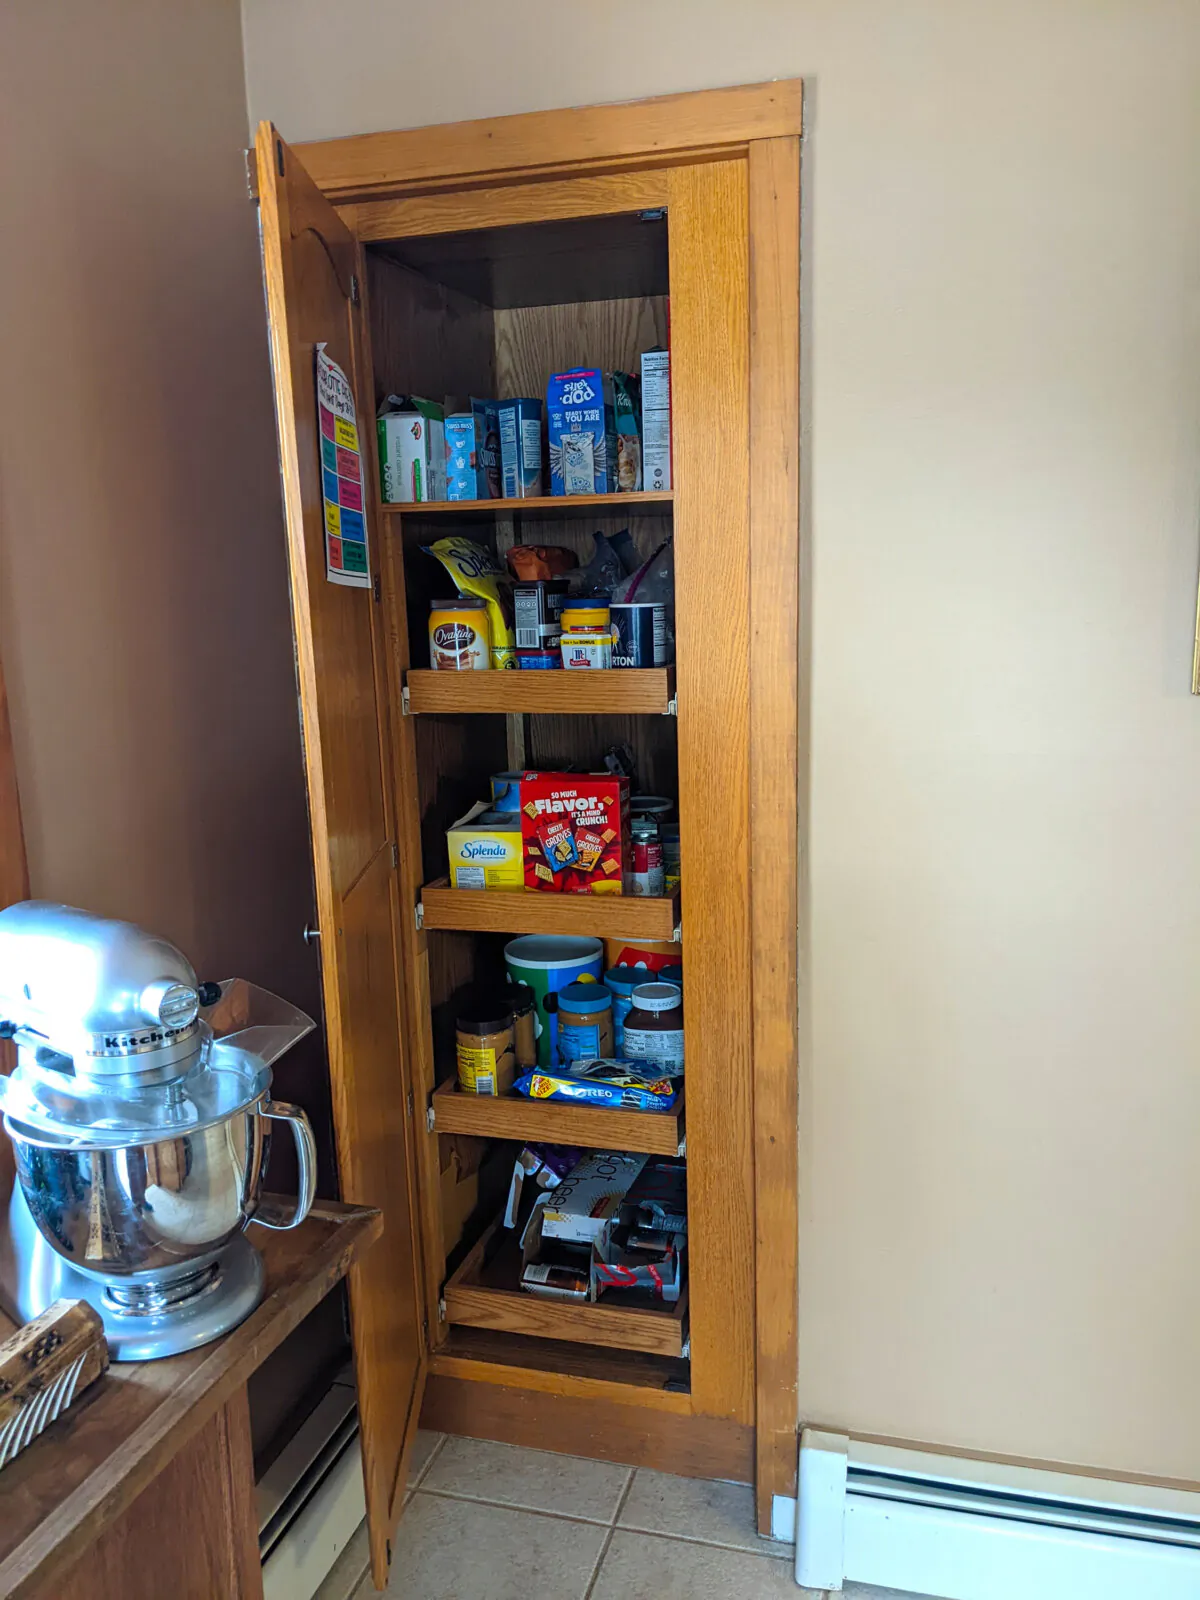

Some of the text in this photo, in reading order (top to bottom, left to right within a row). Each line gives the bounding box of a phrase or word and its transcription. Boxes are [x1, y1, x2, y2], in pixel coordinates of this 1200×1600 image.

[584, 413, 600, 421] ARE
[435, 629, 474, 645] Ovaltine
[612, 656, 635, 666] RTON
[560, 790, 577, 798] MUCH
[534, 796, 604, 815] Flavor,
[575, 816, 608, 827] CRUNCH!
[545, 828, 572, 848] GROOVES
[460, 842, 506, 859] Splenda
[576, 840, 603, 853] GROOVES
[575, 1088, 613, 1098] OREO
[547, 1177, 588, 1214] beer
